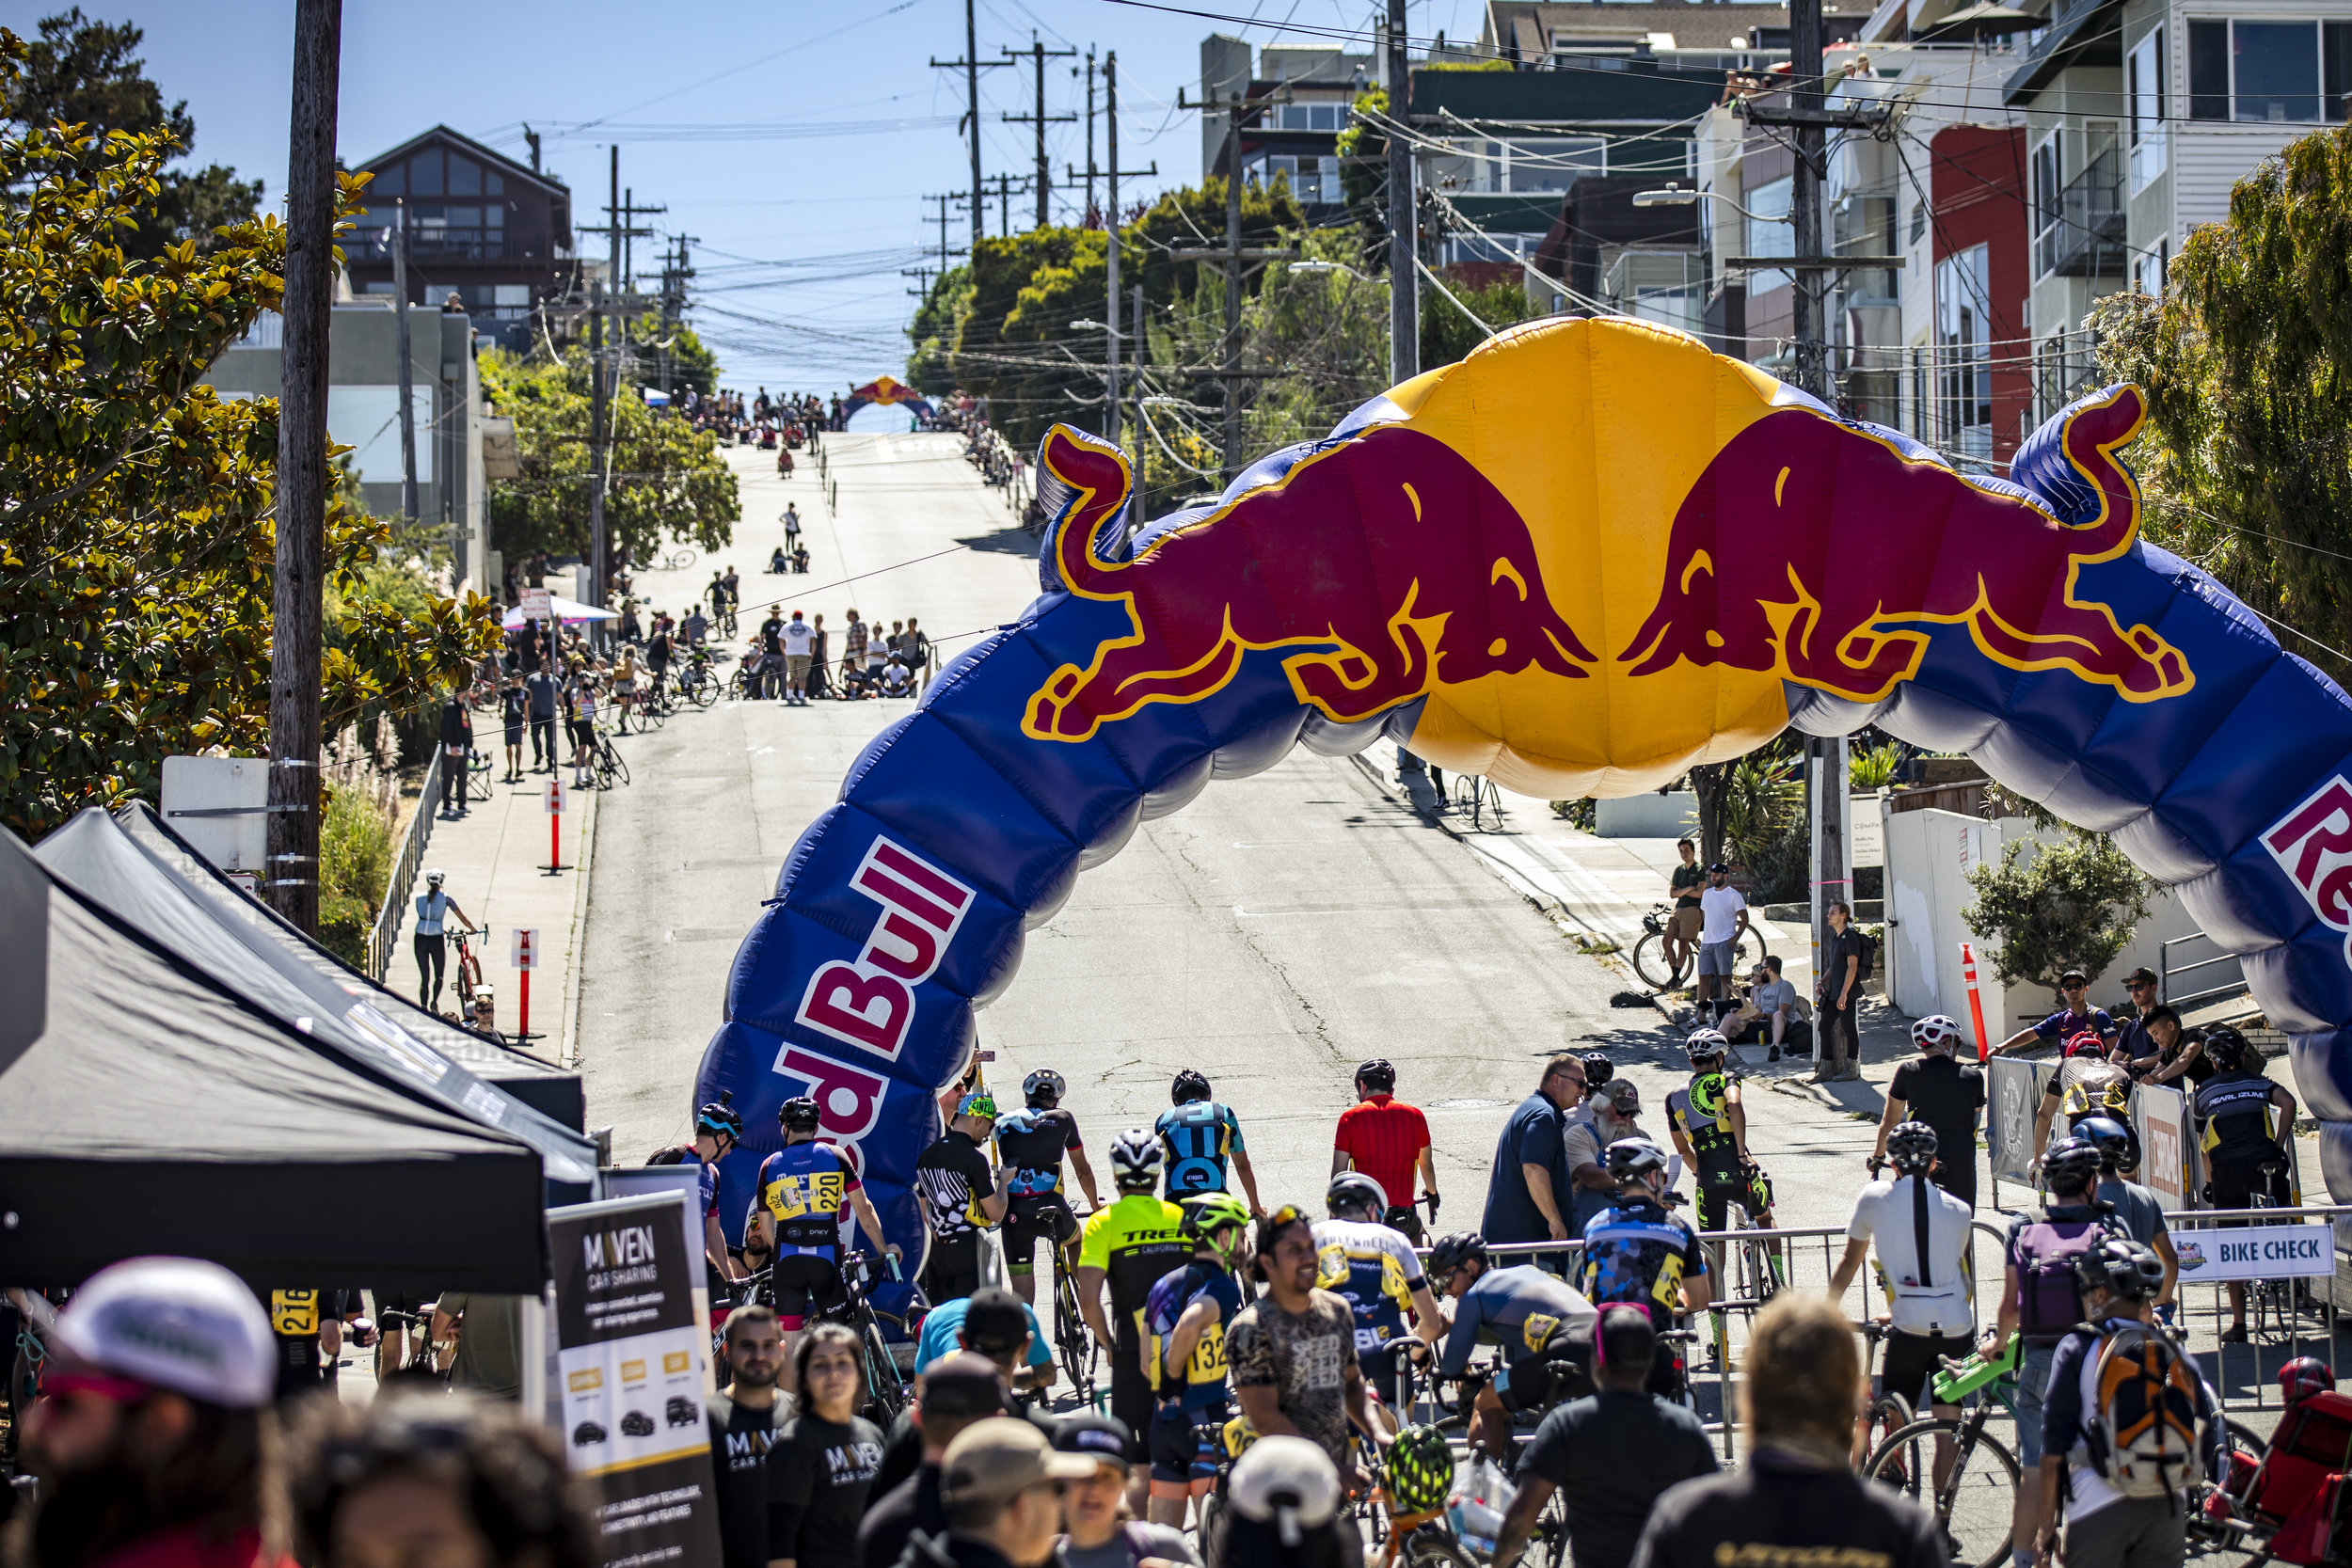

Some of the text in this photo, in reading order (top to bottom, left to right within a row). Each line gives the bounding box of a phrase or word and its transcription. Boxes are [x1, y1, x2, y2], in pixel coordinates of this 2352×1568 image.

[798, 836, 974, 1060] Bull
[2209, 1095, 2237, 1106] PEARL
[819, 1175, 840, 1210] 220
[583, 1225, 656, 1271] MAVEN
[2220, 1239, 2320, 1262] BIKE CHECK
[612, 1263, 658, 1289] SHARING
[283, 1290, 313, 1331] 216
